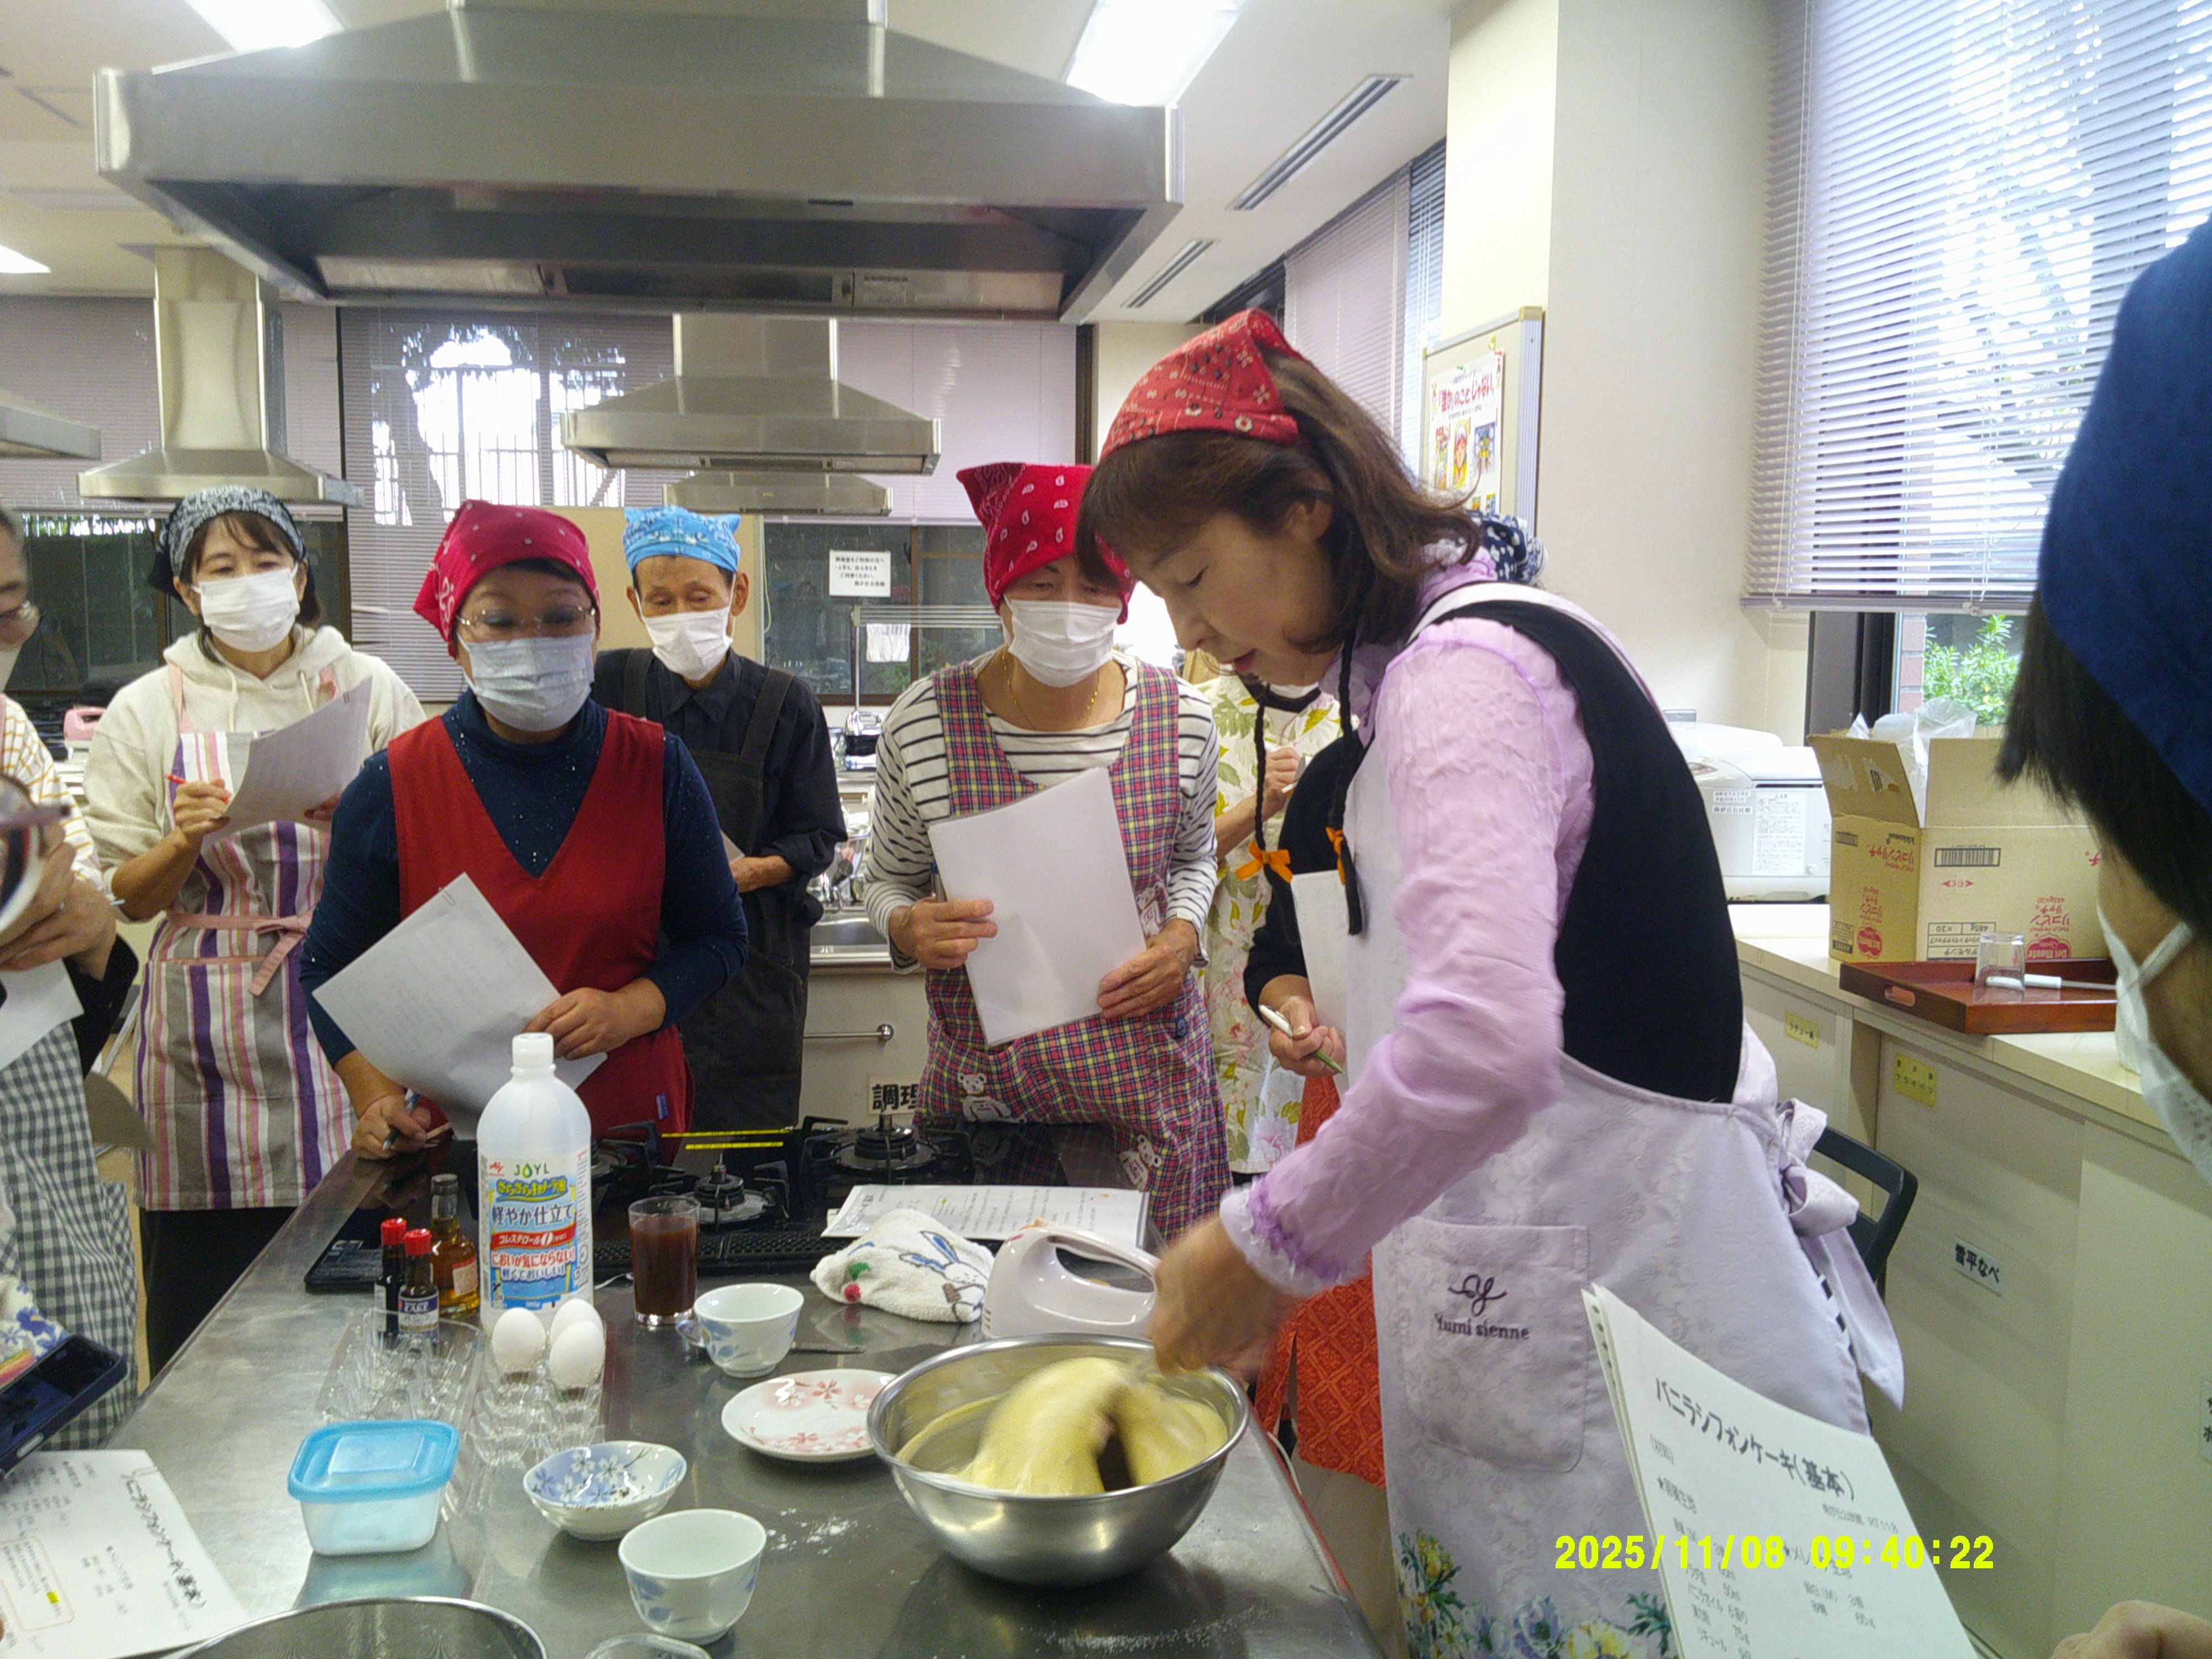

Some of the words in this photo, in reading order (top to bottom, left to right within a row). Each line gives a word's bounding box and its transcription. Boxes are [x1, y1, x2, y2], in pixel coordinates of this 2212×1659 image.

[2030, 913, 2070, 926] リコピン
[492, 1203, 575, 1226] 軽やか仕立て
